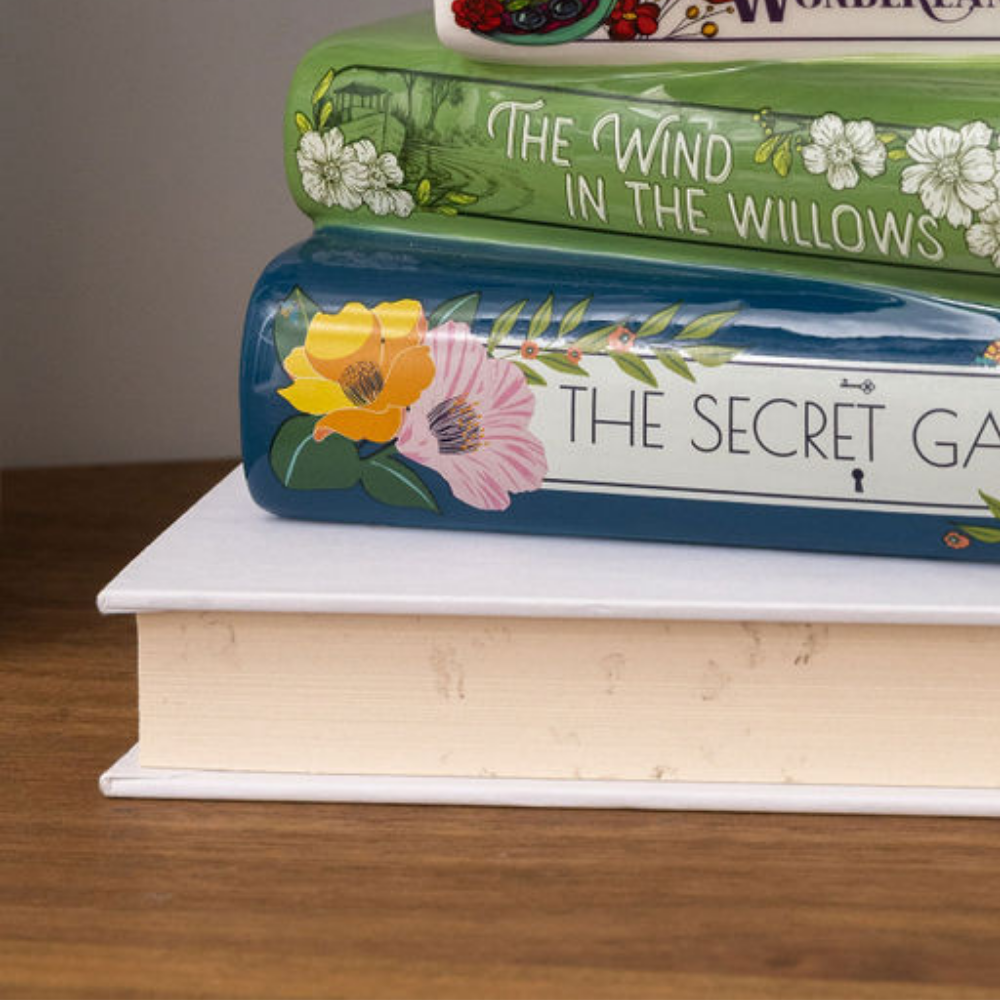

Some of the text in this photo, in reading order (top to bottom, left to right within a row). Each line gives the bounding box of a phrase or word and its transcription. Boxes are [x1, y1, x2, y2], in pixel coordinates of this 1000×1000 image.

[487, 99, 733, 185] THE WIND
[564, 172, 945, 263] IN THE WILLOWS
[559, 384, 665, 449] THE
[690, 393, 886, 463] SECRET
